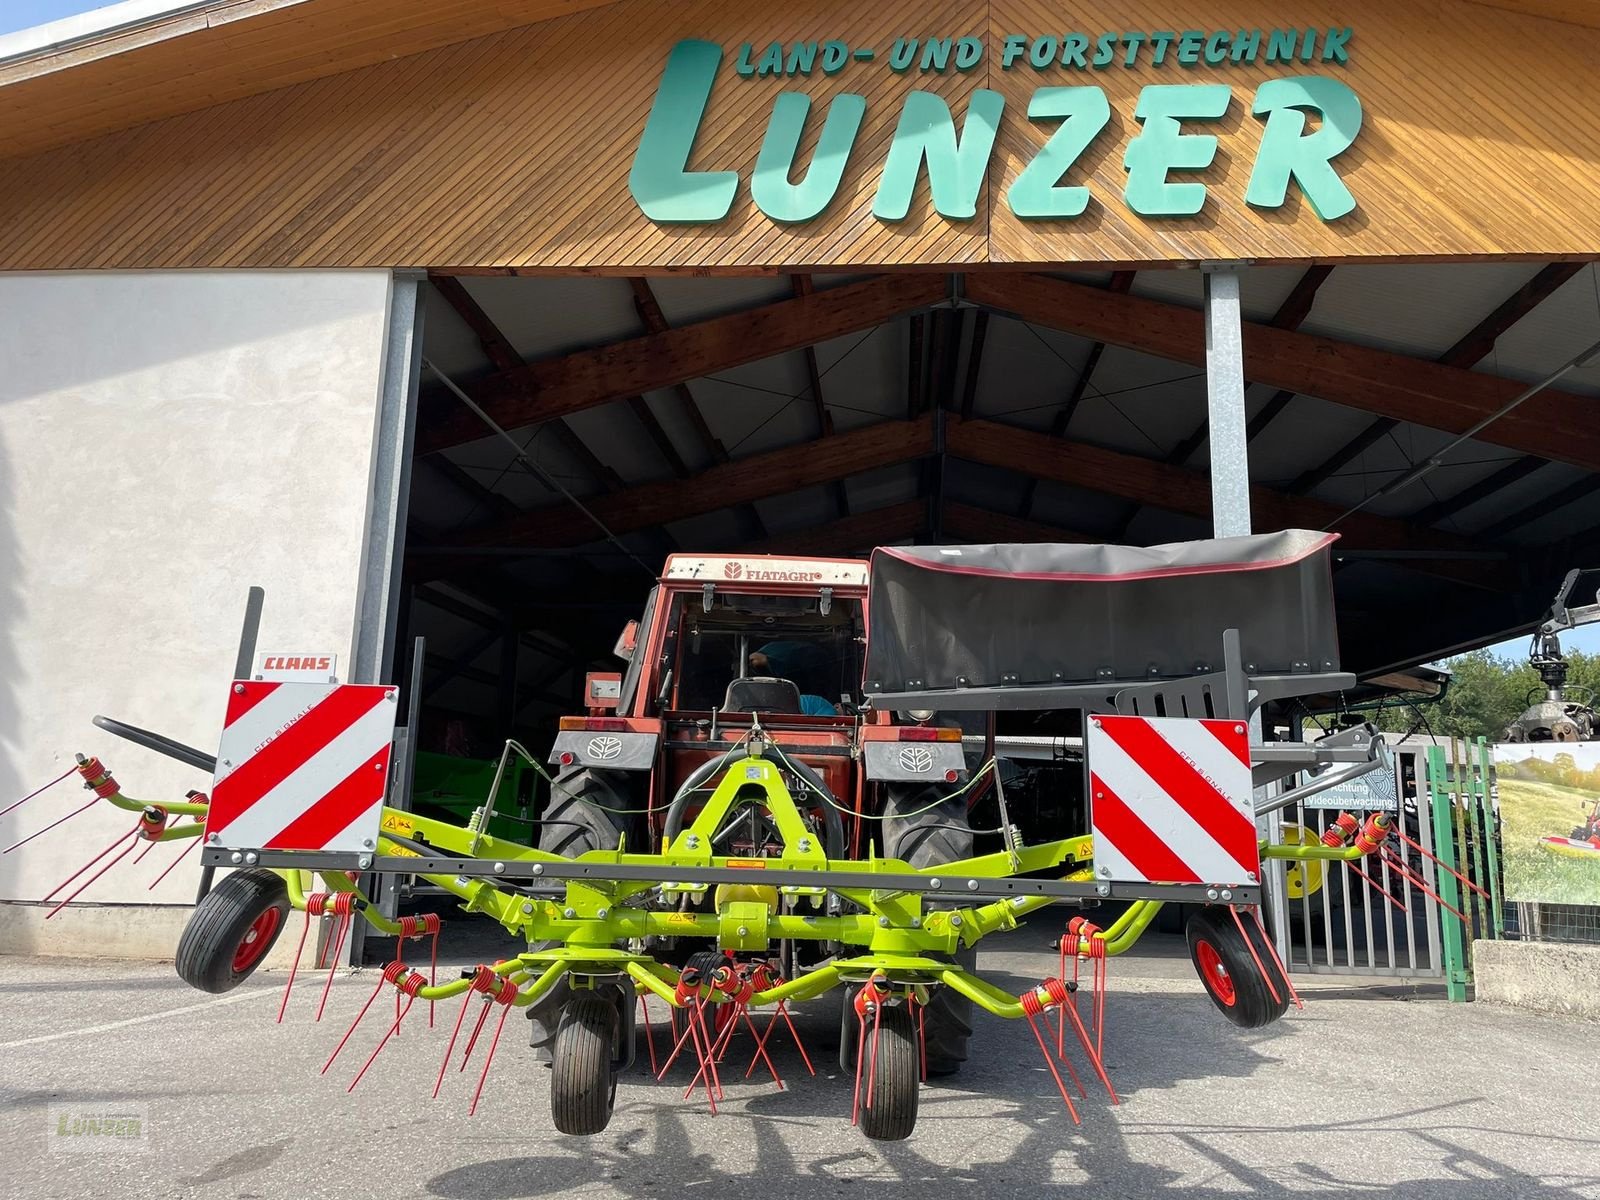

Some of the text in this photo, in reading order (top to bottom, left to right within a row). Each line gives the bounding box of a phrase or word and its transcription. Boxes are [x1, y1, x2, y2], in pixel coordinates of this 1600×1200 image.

[735, 27, 1352, 78] LAND- UND FORSTTECHNIK
[628, 39, 1363, 223] LUNZER
[746, 569, 816, 582] FIATAGRI
[264, 657, 330, 670] CLAAS
[1331, 783, 1369, 794] Achtung
[1308, 796, 1393, 809] Videoüberwachung
